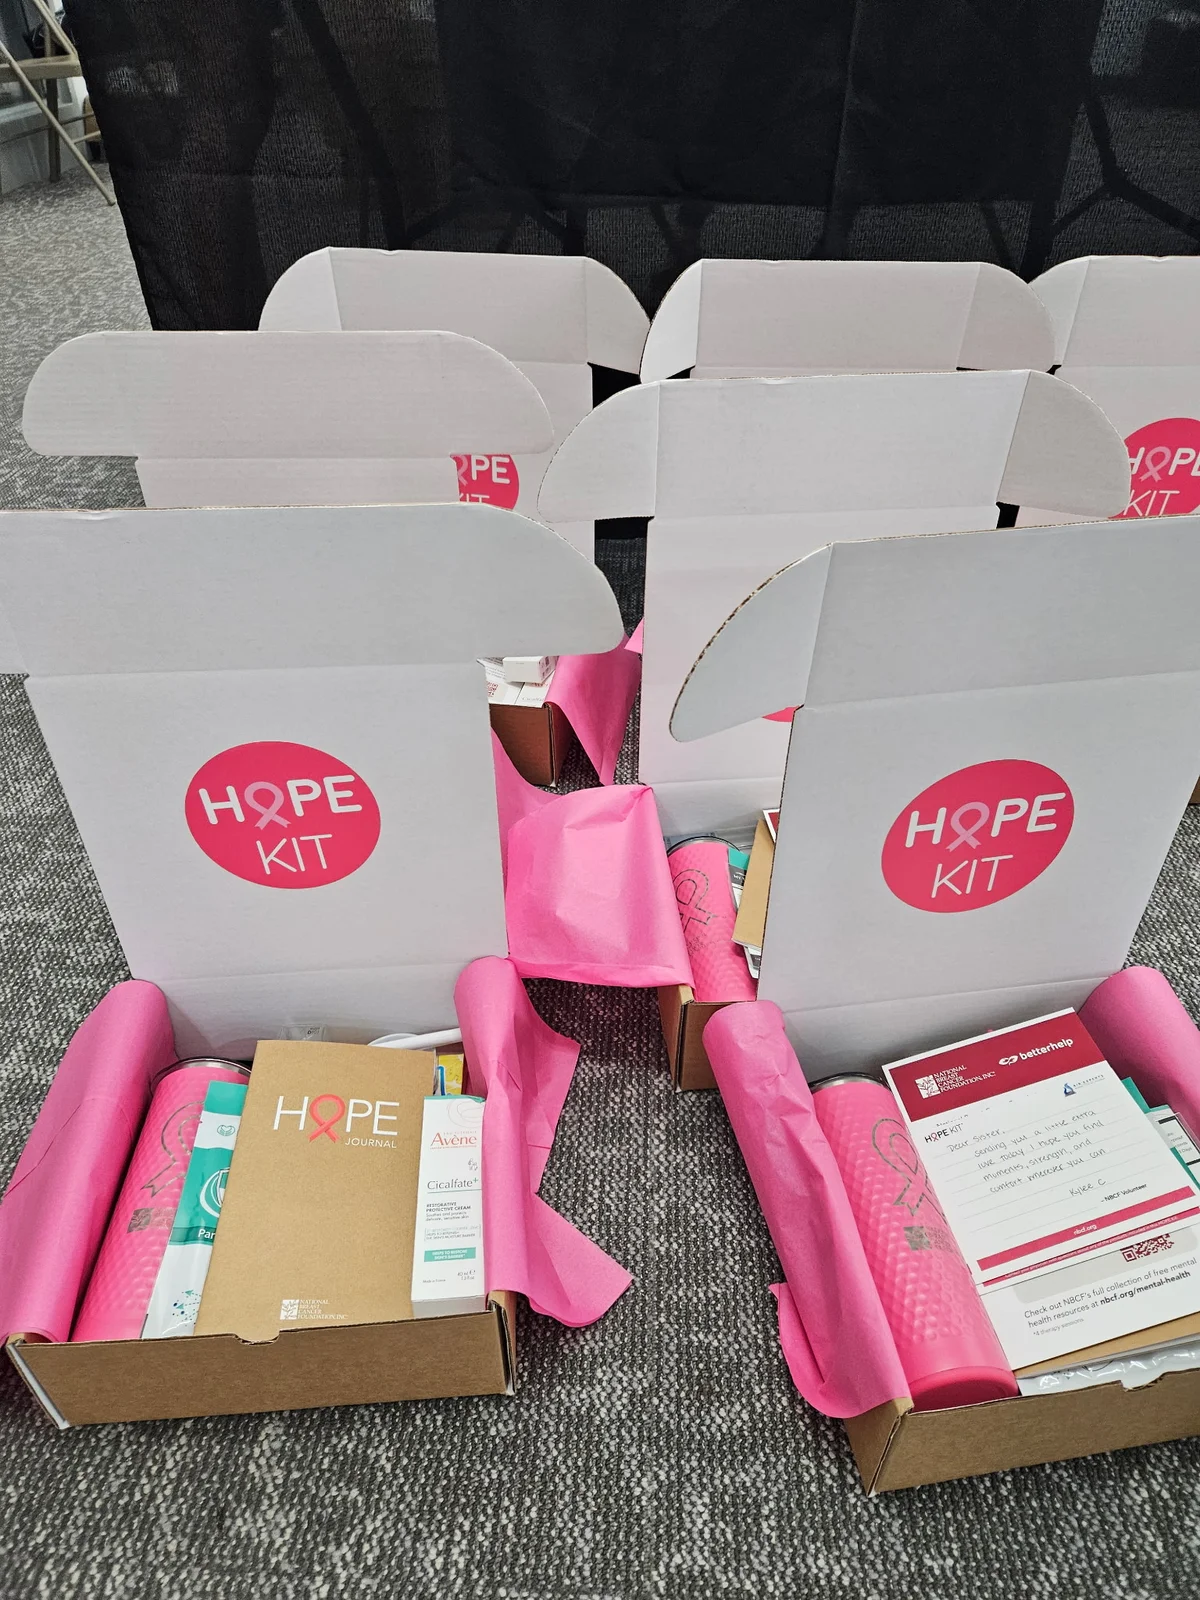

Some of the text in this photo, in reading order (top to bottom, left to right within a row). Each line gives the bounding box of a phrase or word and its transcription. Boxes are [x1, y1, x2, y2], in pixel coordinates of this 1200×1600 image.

[1123, 489, 1180, 516] KIT
[199, 774, 363, 830] HOPE
[905, 792, 1066, 852] HOPE
[256, 834, 332, 875] KIT
[931, 854, 1014, 898] KIT
[1019, 1038, 1074, 1060] betterhelp
[933, 1064, 967, 1079] NATIONAL
[936, 1072, 958, 1083] BREAST
[938, 1076, 964, 1088] CANCER
[273, 1094, 400, 1142] HOPE
[1011, 1135, 1028, 1145] you
[1044, 1120, 1068, 1131] little
[1072, 1110, 1096, 1121] extra
[345, 1137, 397, 1148] JOURNAL
[430, 1132, 477, 1147] Avène
[924, 1128, 949, 1143] HOPE
[1038, 1137, 1061, 1147] hope
[1063, 1130, 1080, 1140] you
[1083, 1119, 1104, 1131] find
[946, 1140, 969, 1152] Dear
[1073, 1138, 1092, 1151] and
[990, 1178, 1022, 1193] comfort
[1066, 1158, 1084, 1168] you
[1089, 1148, 1106, 1159] can
[1069, 1178, 1106, 1196] Kylee C
[1104, 1191, 1121, 1202] NBCF
[1121, 1184, 1147, 1196] Volunteer
[1073, 1224, 1097, 1235] nbcf.org
[1024, 1305, 1048, 1318] Check
[1049, 1302, 1062, 1311] out
[1092, 1286, 1105, 1297] full
[1106, 1276, 1142, 1292] collection
[1144, 1271, 1152, 1280] of
[1153, 1267, 1169, 1277] free
[1170, 1257, 1197, 1271] mental
[1028, 1270, 1191, 1328] health resources at nbcf.org/mental-health
